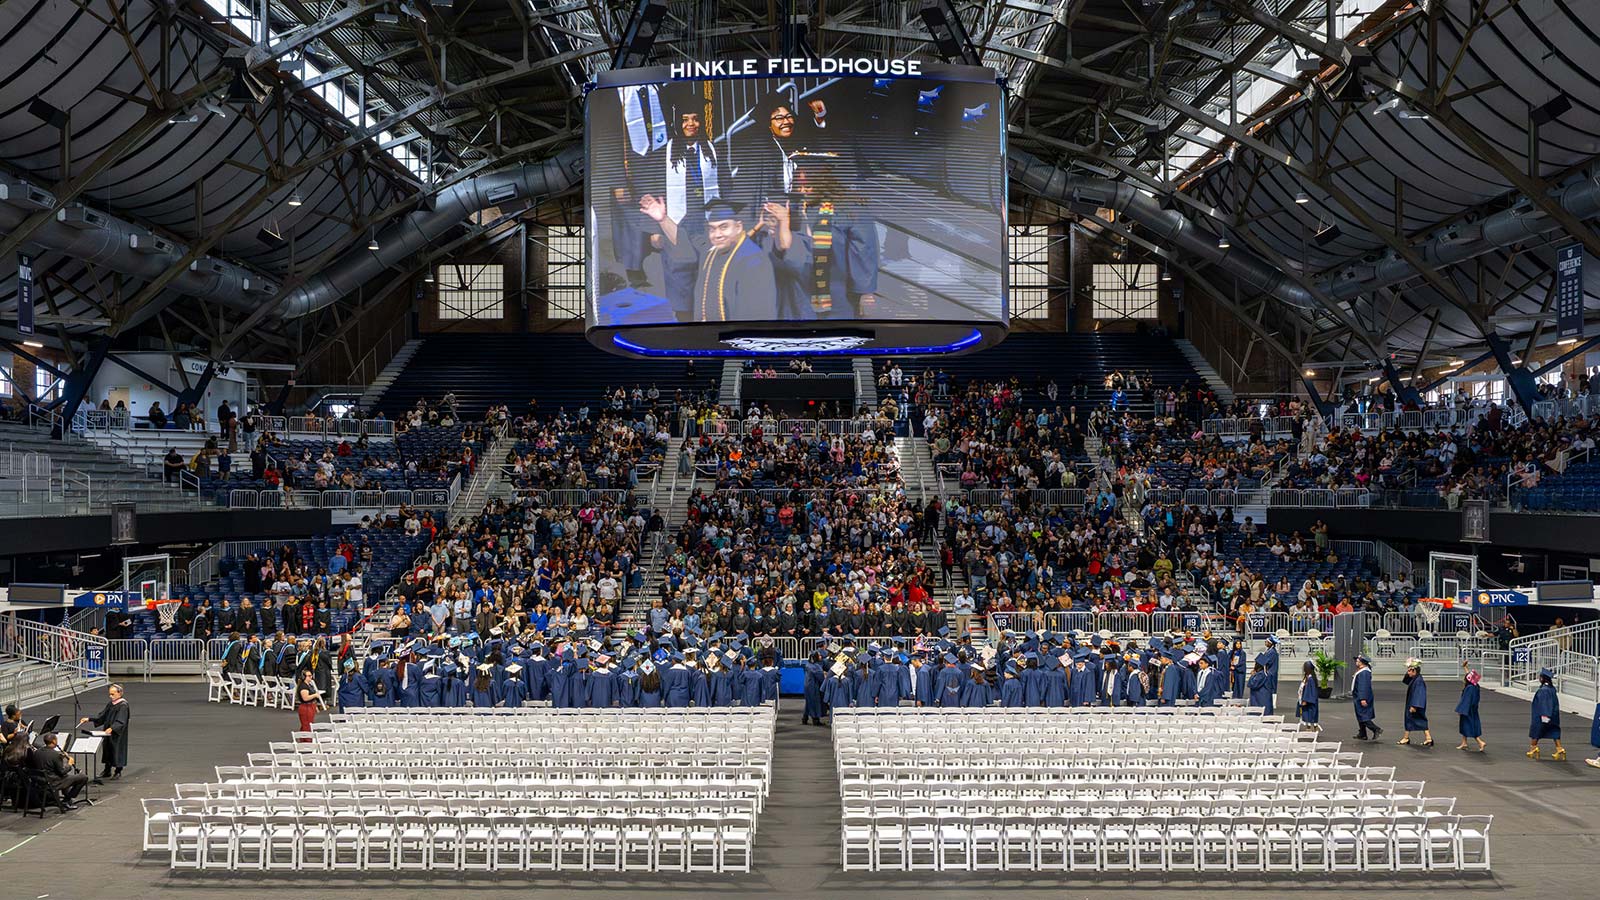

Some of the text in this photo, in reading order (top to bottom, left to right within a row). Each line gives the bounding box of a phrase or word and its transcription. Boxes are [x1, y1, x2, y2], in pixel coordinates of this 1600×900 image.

[670, 58, 922, 78] HINKLE FIELDHOUSE
[106, 594, 123, 604] PN
[1491, 593, 1515, 603] PNC
[997, 618, 1007, 627] 119
[1186, 618, 1196, 627] 119
[1455, 619, 1468, 627] 120
[383, 645, 391, 653] 17
[90, 650, 101, 659] 112
